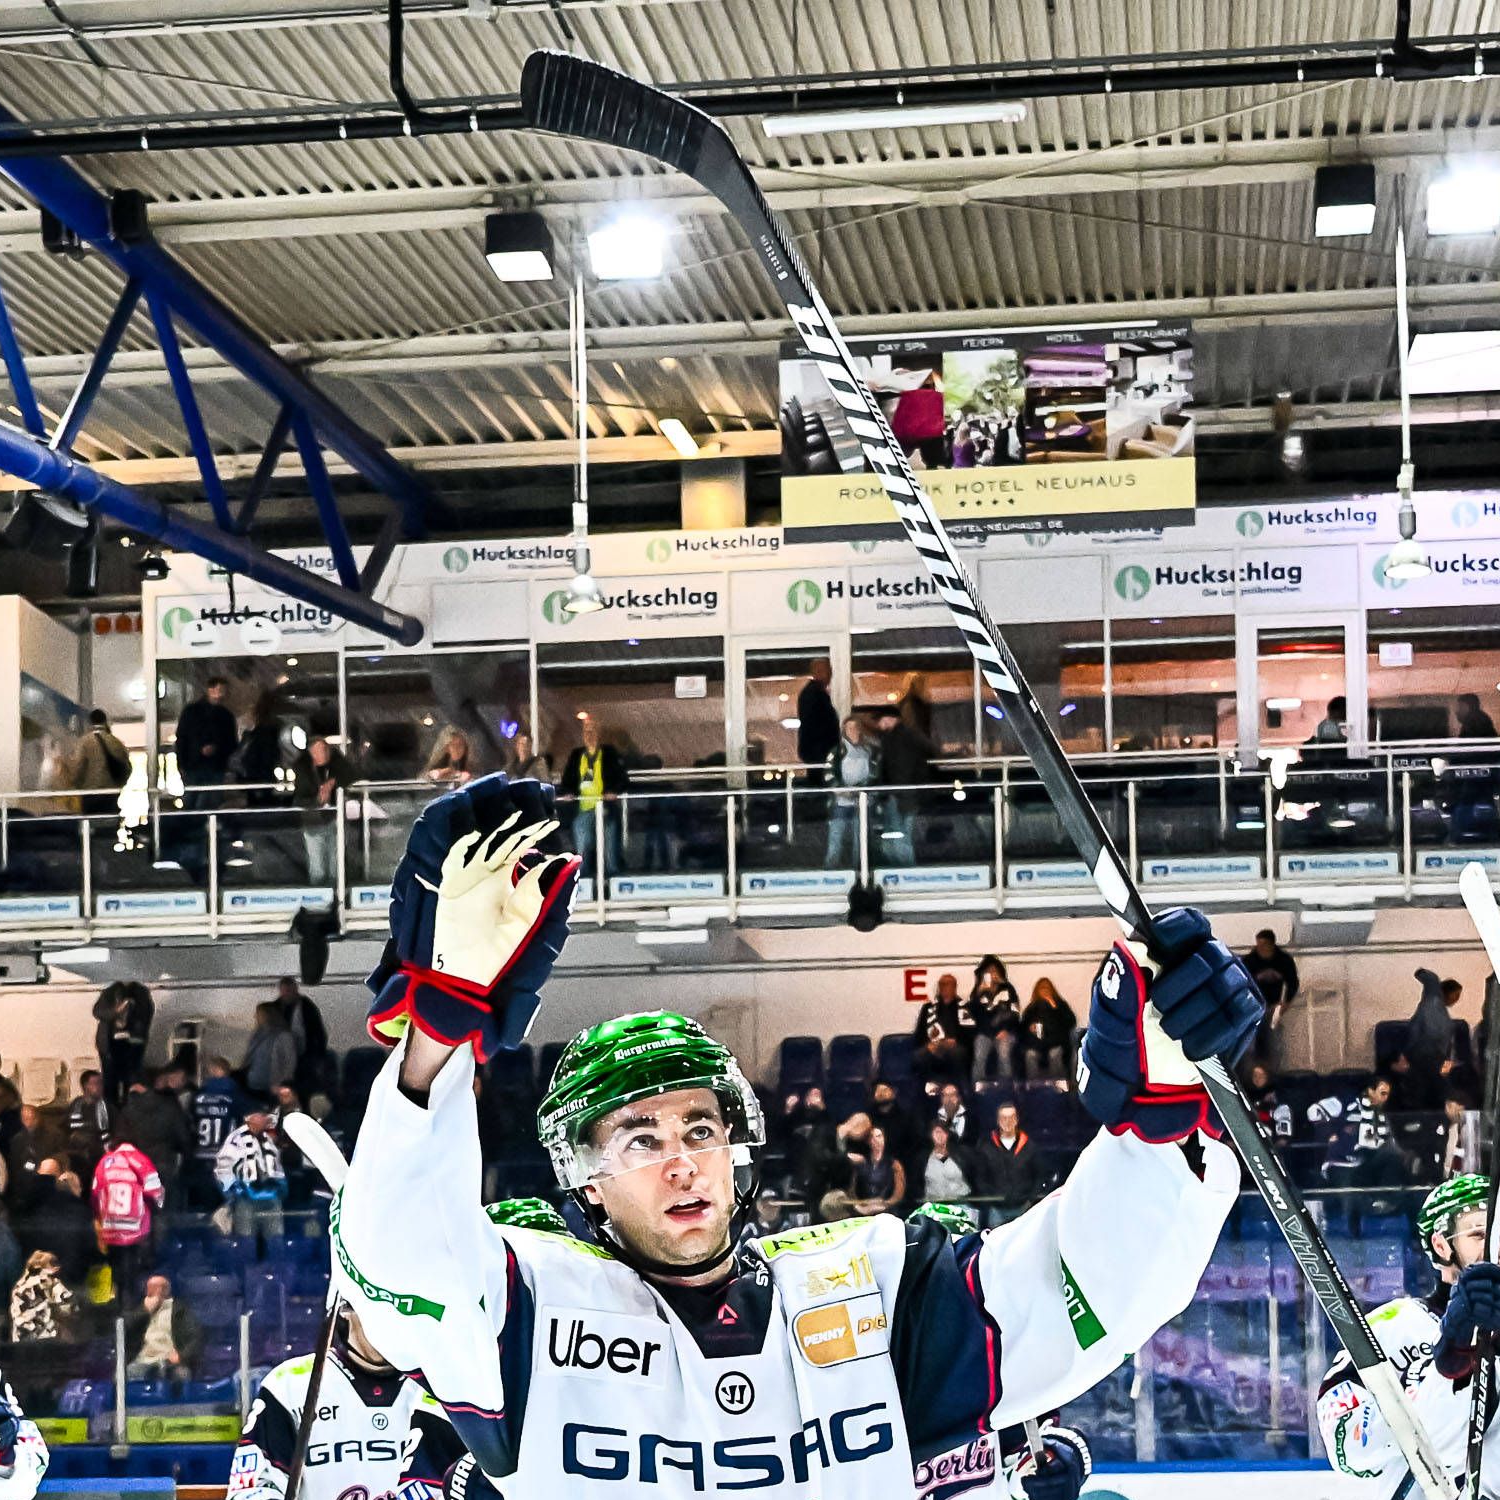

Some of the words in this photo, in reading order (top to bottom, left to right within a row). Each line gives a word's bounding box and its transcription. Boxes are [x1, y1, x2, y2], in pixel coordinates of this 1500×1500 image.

[1047, 332, 1084, 343] HOTEL
[787, 303, 1020, 694] WARRIOR
[839, 480, 944, 500] ROMIK
[955, 479, 1023, 496] HOTEL
[1037, 473, 1136, 491] NEUHAUS
[1268, 508, 1377, 527] Huckschlag
[676, 534, 779, 553] Huckschlag
[1155, 560, 1302, 588] Huckschlag
[600, 588, 719, 611] uckschlag
[826, 576, 938, 600] Huckschl
[904, 968, 927, 1001] E
[549, 1318, 661, 1377] Uber
[803, 1325, 848, 1349] PENNY
[562, 1403, 893, 1491] GASAG
